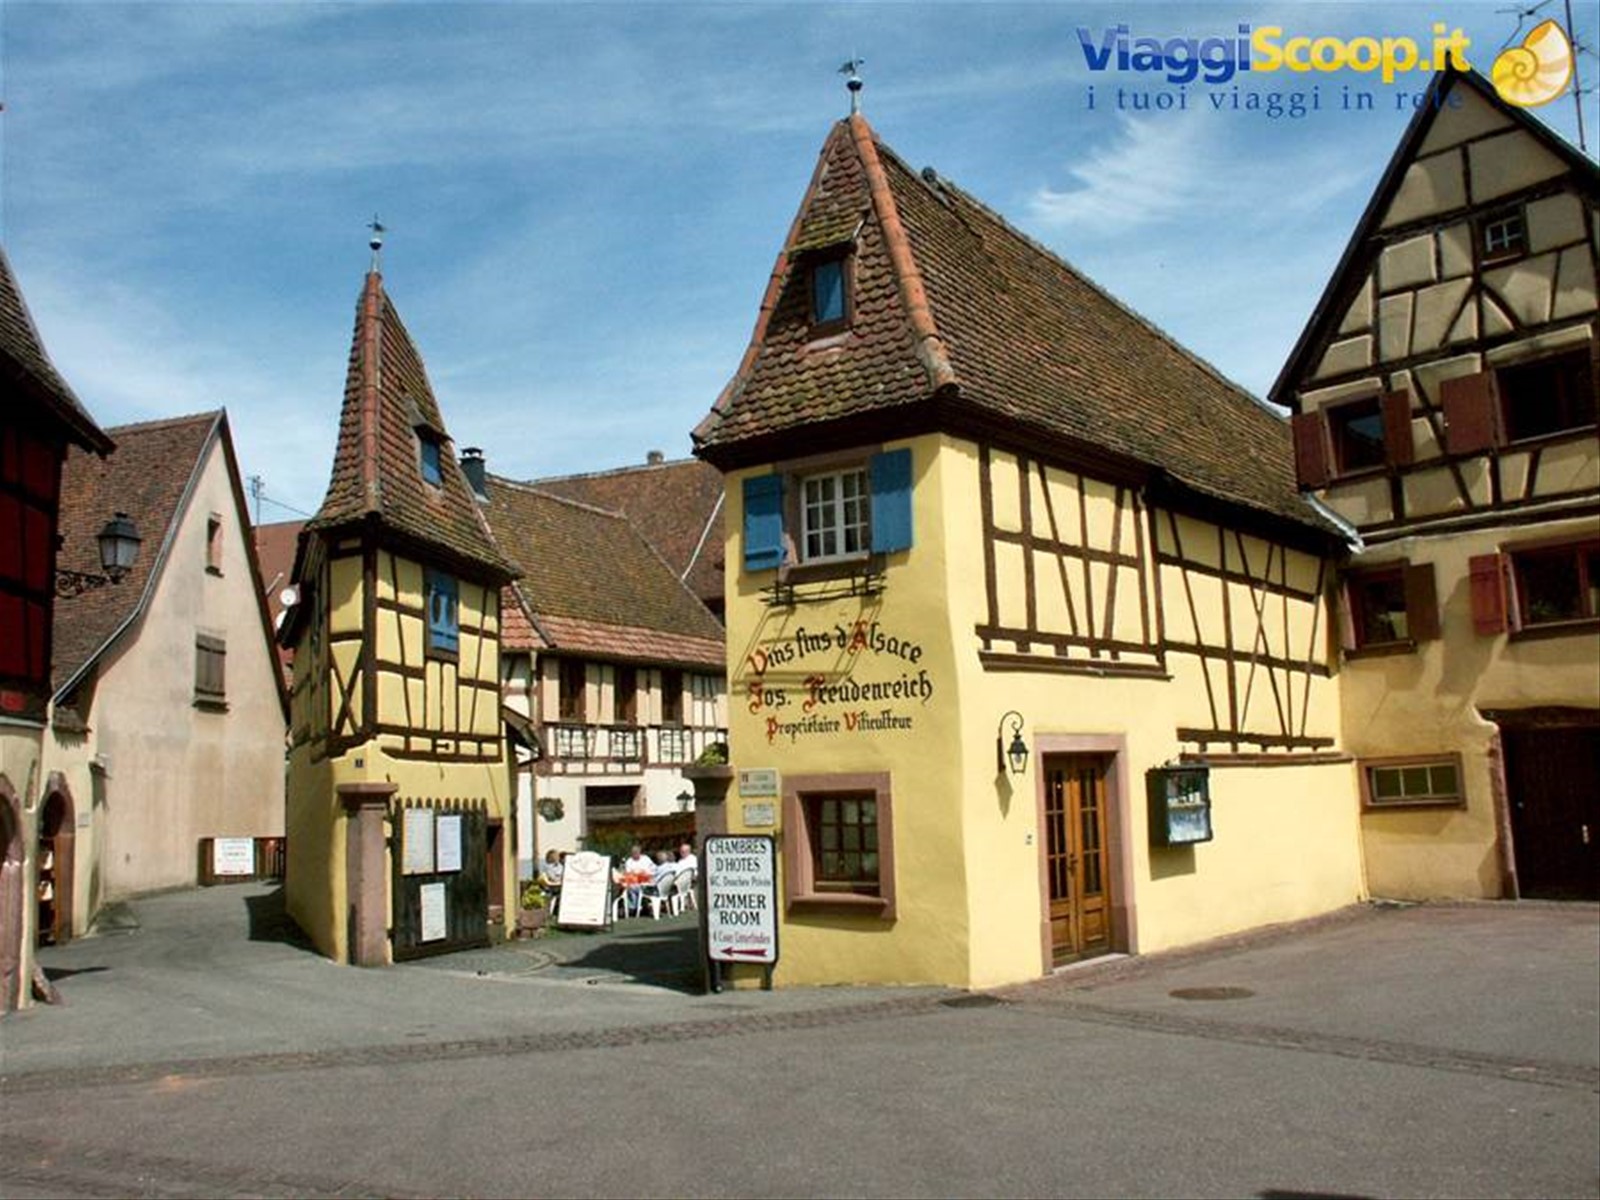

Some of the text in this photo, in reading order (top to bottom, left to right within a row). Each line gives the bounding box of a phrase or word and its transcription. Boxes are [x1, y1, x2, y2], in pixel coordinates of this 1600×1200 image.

[747, 642, 795, 676] Vins
[796, 626, 831, 658] fins
[748, 670, 933, 714] Jos. Freudenreich
[709, 839, 766, 854] CHAMBRES
[713, 894, 766, 909] ZIMMER
[720, 911, 760, 925] ROOM
